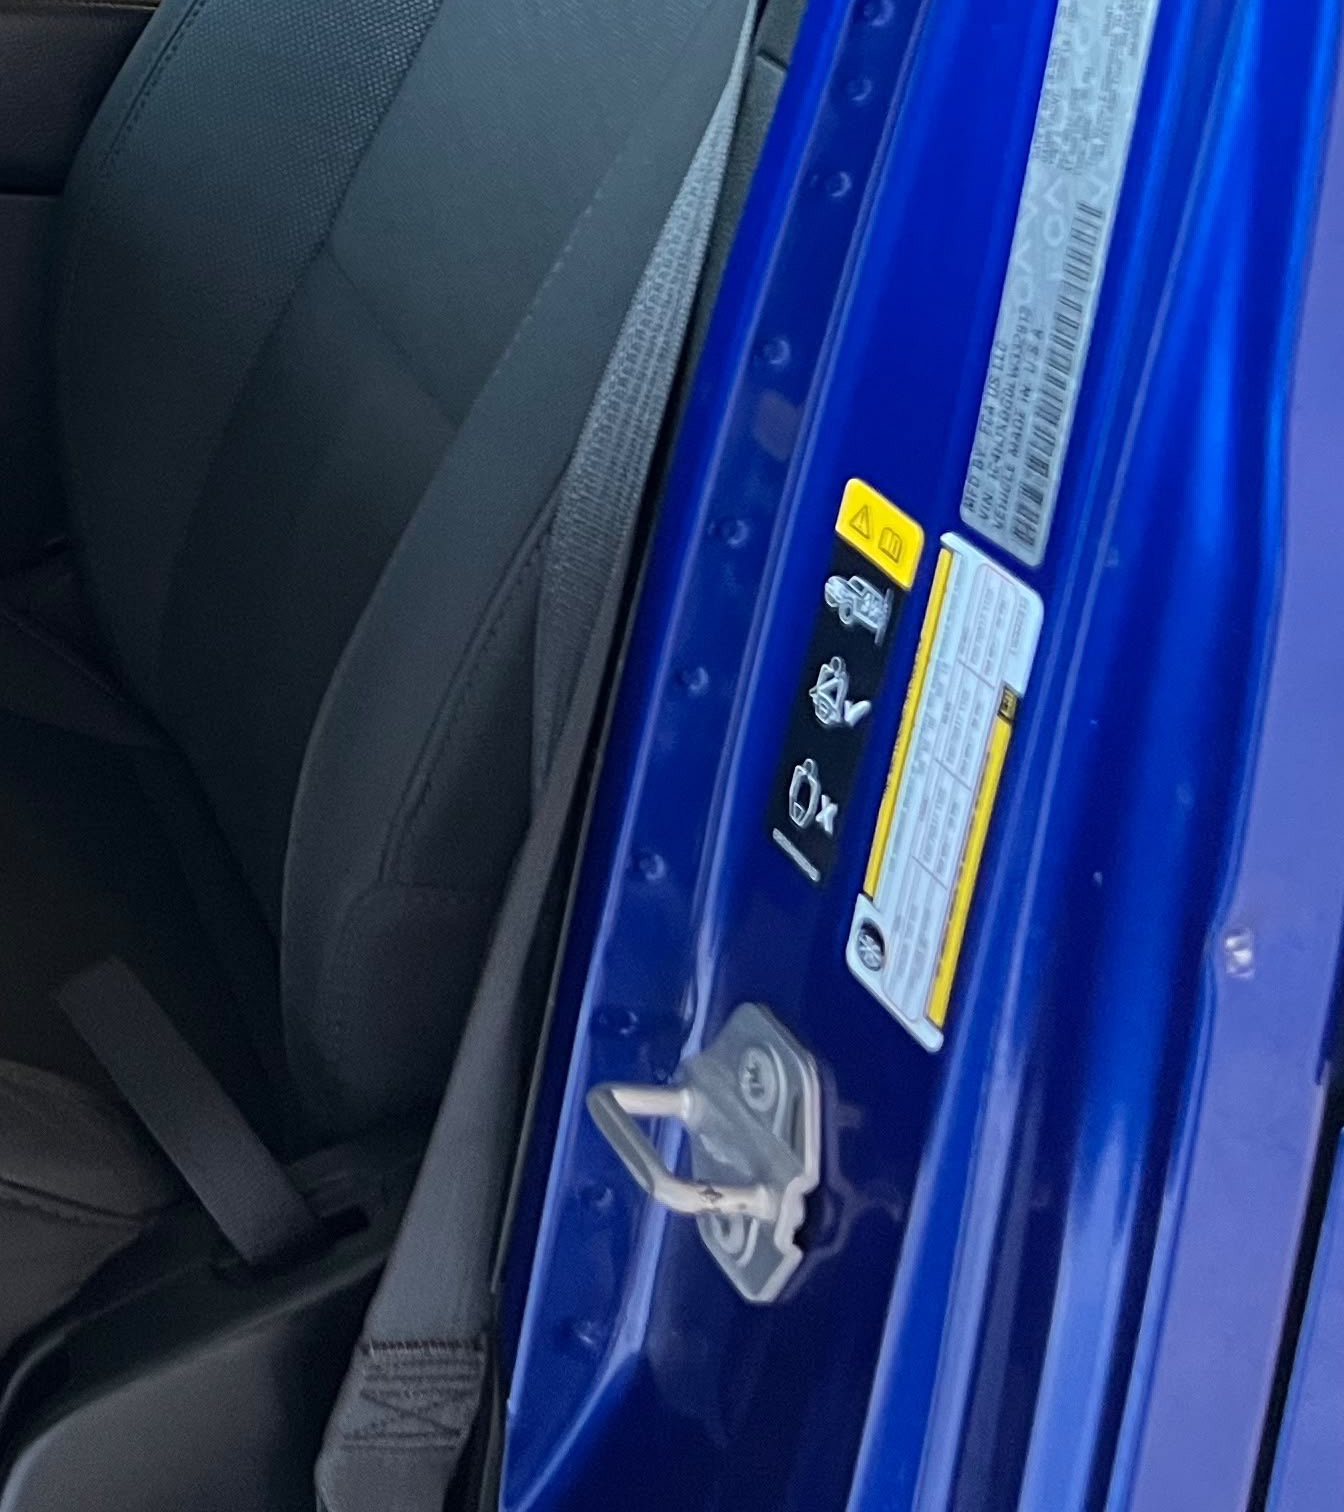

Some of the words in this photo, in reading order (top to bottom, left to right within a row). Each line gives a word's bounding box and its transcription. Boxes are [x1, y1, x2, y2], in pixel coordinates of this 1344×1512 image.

[987, 376, 1001, 398] US
[993, 463, 1016, 529] VEHICLE
[1009, 406, 1026, 457] MADE
